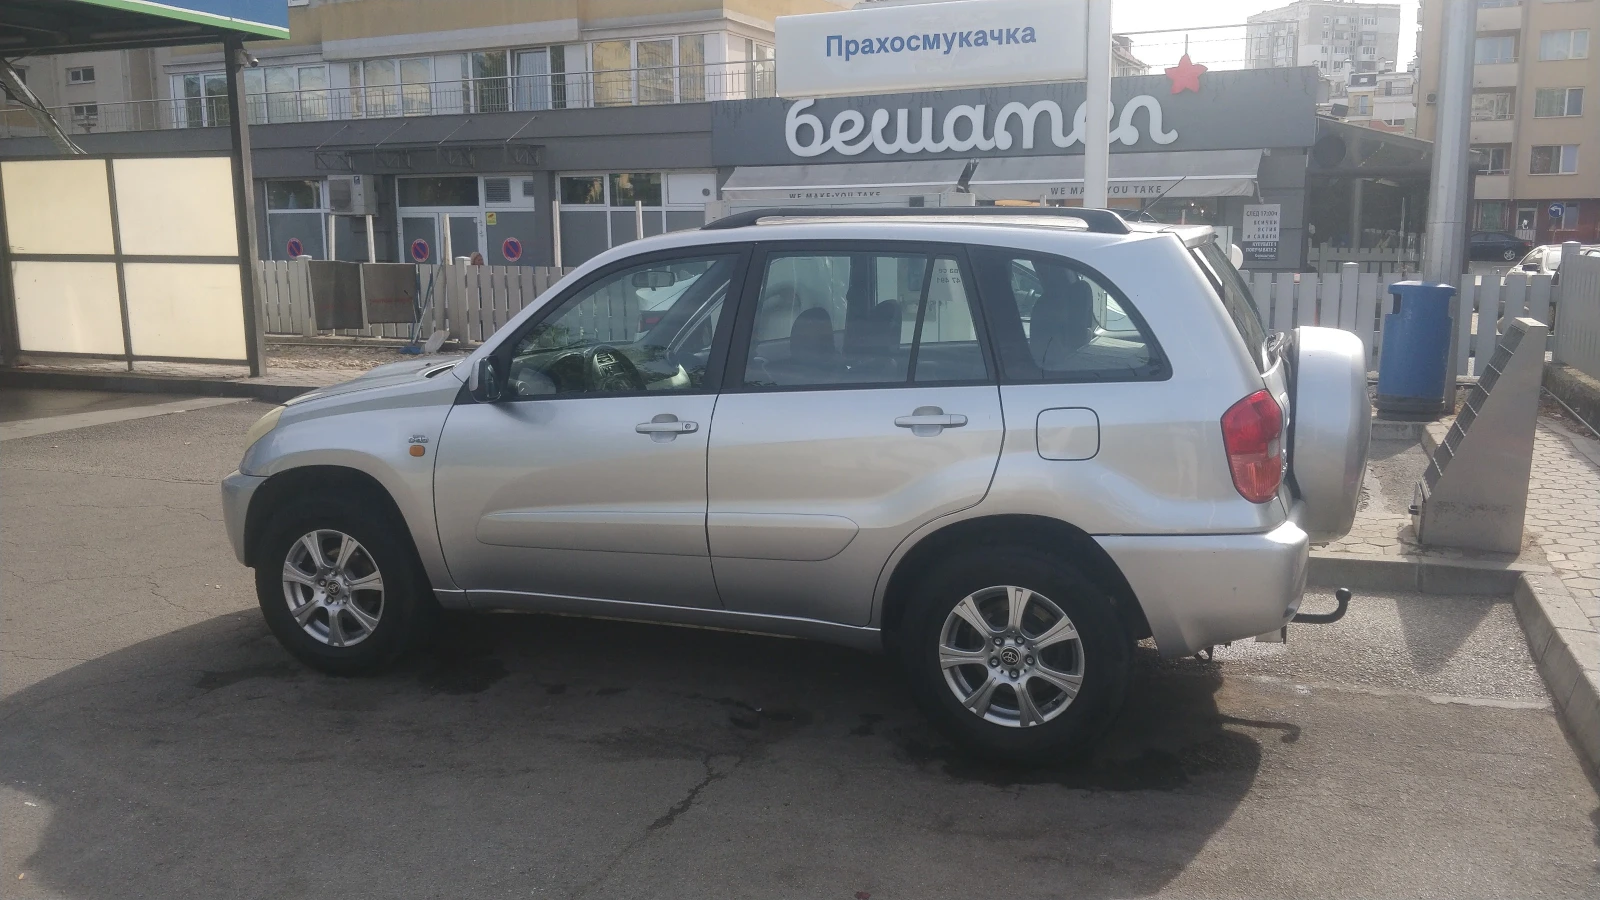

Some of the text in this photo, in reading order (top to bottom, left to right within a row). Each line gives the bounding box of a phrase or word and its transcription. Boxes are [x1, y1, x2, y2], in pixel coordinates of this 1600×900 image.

[826, 26, 1037, 62] Прахосмукачка
[1050, 187, 1066, 195] WE
[1107, 186, 1129, 194] YOU
[1133, 185, 1162, 194] TAKE
